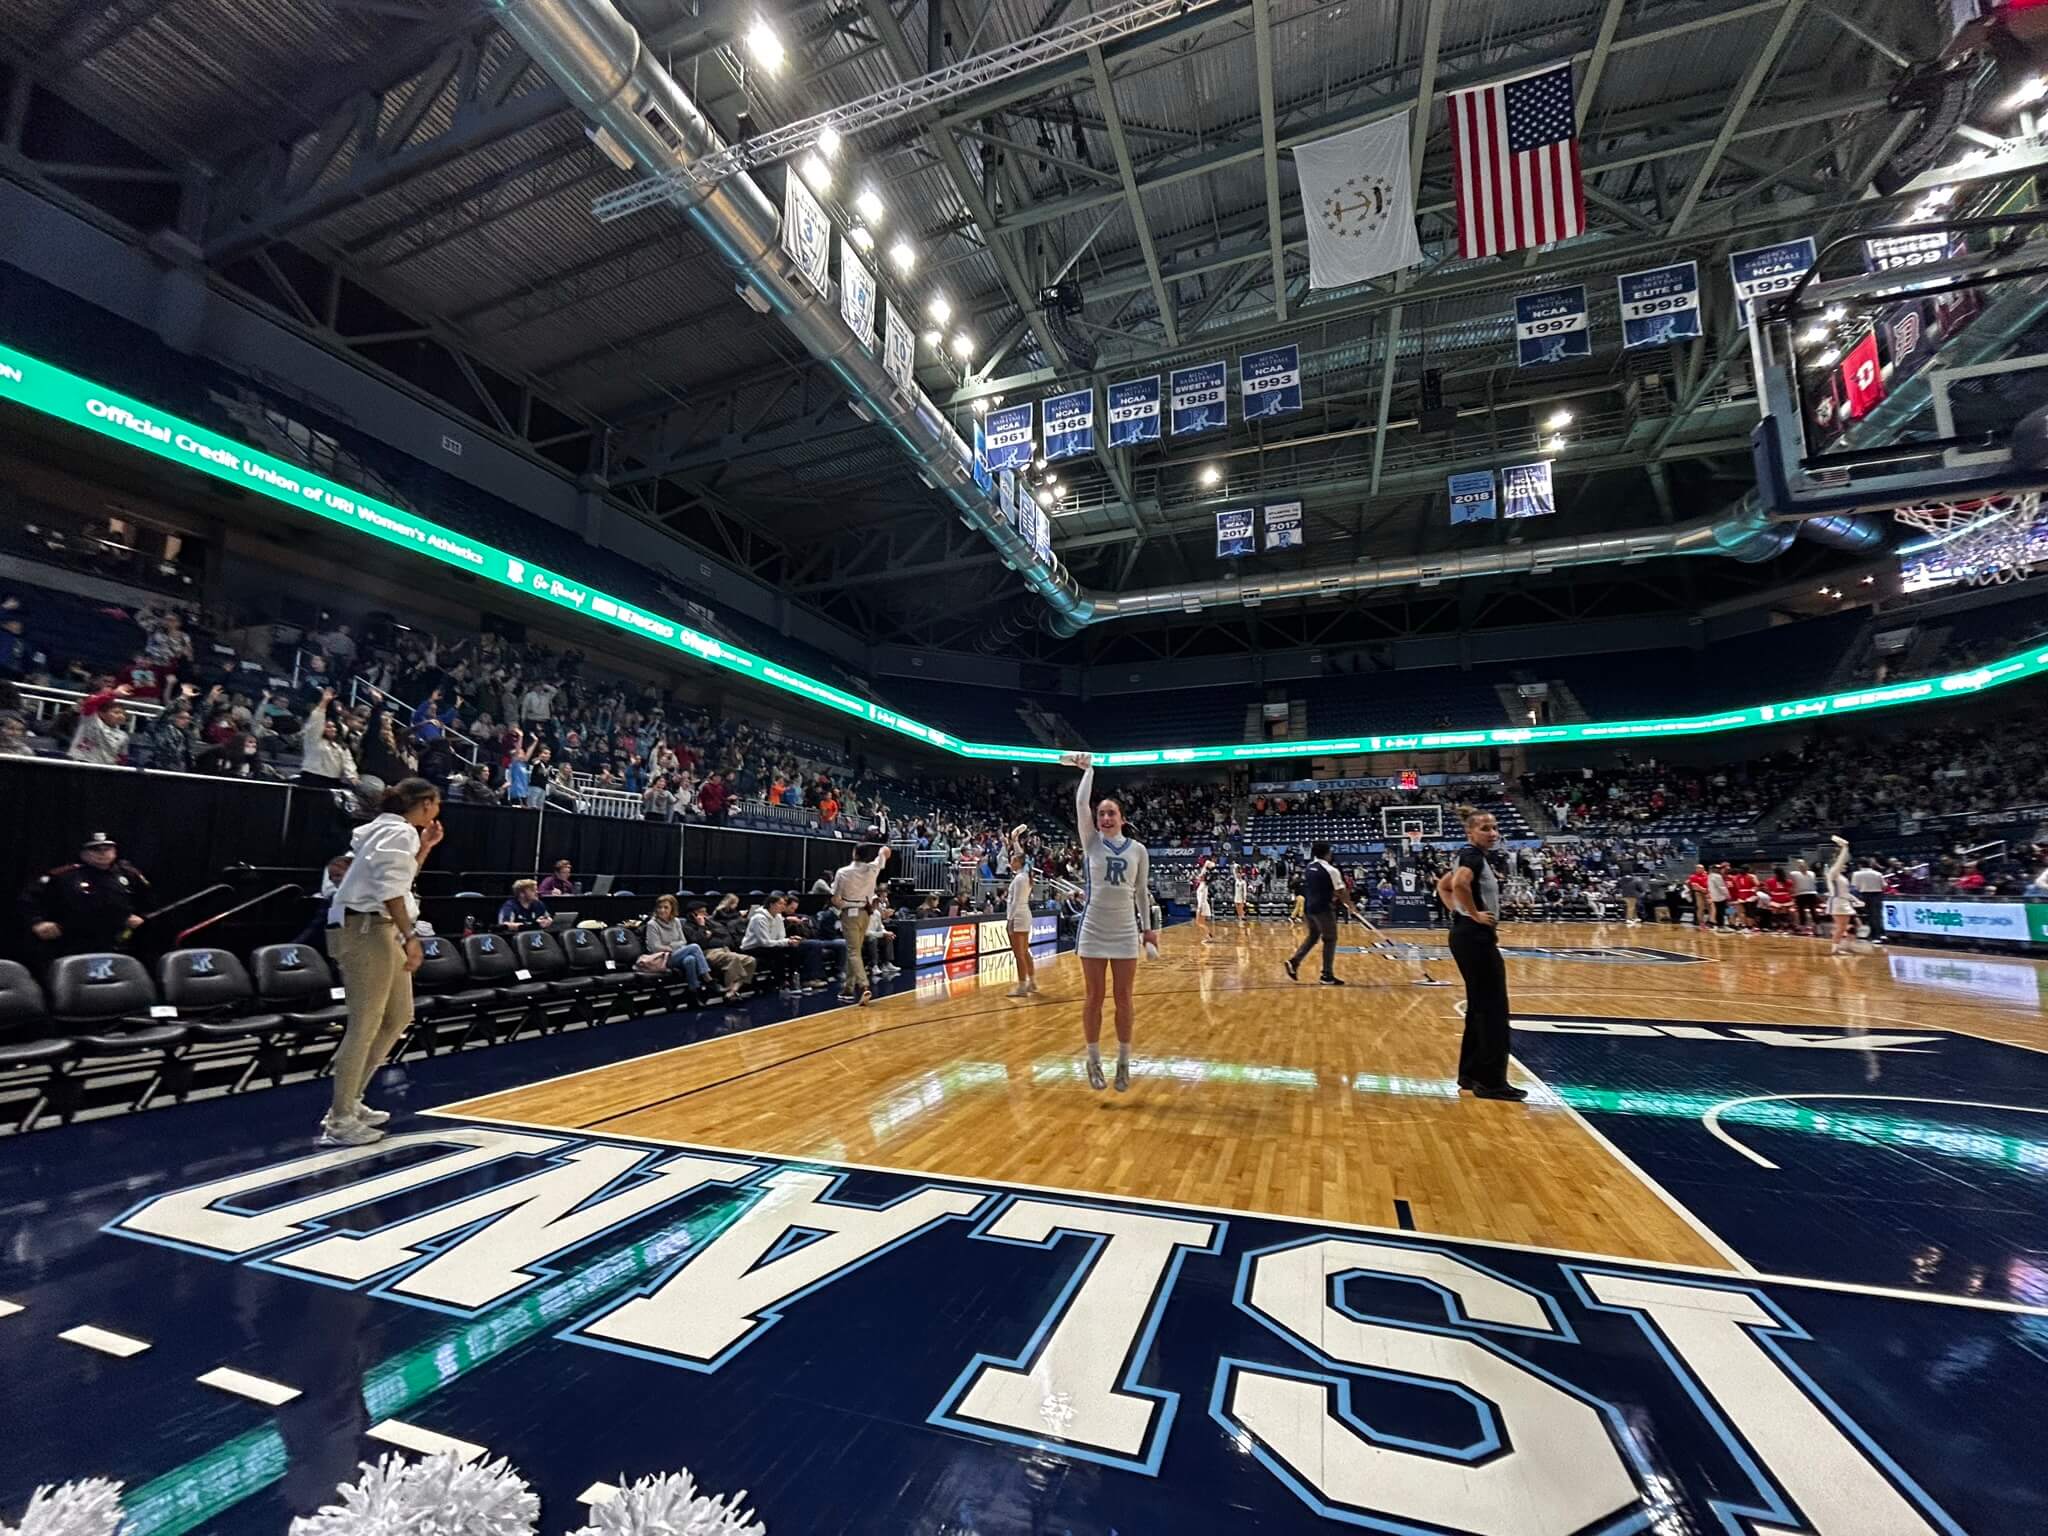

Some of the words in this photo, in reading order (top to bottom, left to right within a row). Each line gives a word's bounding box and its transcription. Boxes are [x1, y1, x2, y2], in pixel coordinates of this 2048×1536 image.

[1878, 250, 1941, 270] 1999
[1752, 262, 1795, 277] NCAA
[1633, 287, 1670, 299] ELITE
[1631, 296, 1688, 315] 1998
[1533, 307, 1568, 318] NCAA
[1525, 317, 1578, 335] 1997
[1255, 365, 1284, 376] NCAA
[1175, 382, 1209, 394] SWEET
[1249, 375, 1292, 391] 1993
[1120, 395, 1146, 405] NCAA
[1178, 391, 1219, 407] 1988
[1055, 408, 1080, 418] NCAA
[1114, 404, 1153, 419] 1978
[996, 421, 1020, 432] NCAA
[1050, 417, 1087, 432] 1966
[993, 432, 1025, 445] 1961
[86, 398, 171, 443] Official
[175, 434, 239, 470] Credit
[242, 459, 300, 493] Union
[303, 487, 323, 501] of
[357, 504, 426, 542] Women's
[427, 534, 483, 564] Athletics
[1455, 492, 1490, 504] 2018
[1270, 521, 1298, 531] 2017
[1222, 529, 1248, 538] 2017
[1317, 777, 1386, 790] STUDENT
[102, 1127, 1965, 1536] ISLAND
